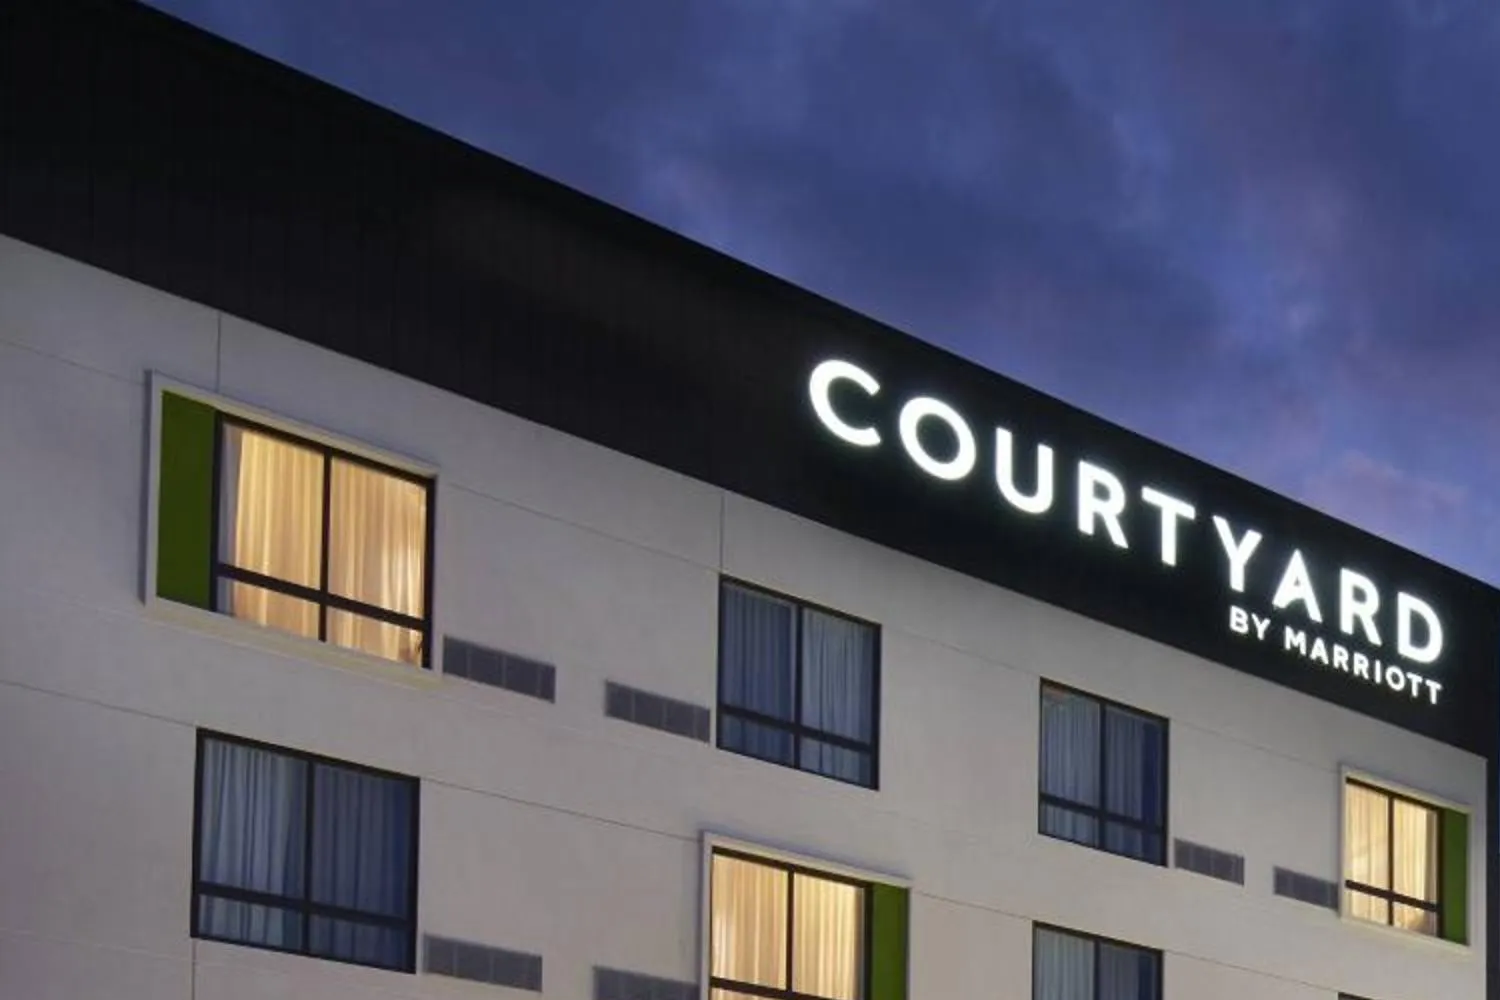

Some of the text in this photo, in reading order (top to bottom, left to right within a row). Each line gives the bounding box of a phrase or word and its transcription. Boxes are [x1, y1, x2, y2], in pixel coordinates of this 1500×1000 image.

[808, 359, 1444, 664] COURTYARD
[1229, 605, 1442, 705] BY MARRIOTT
